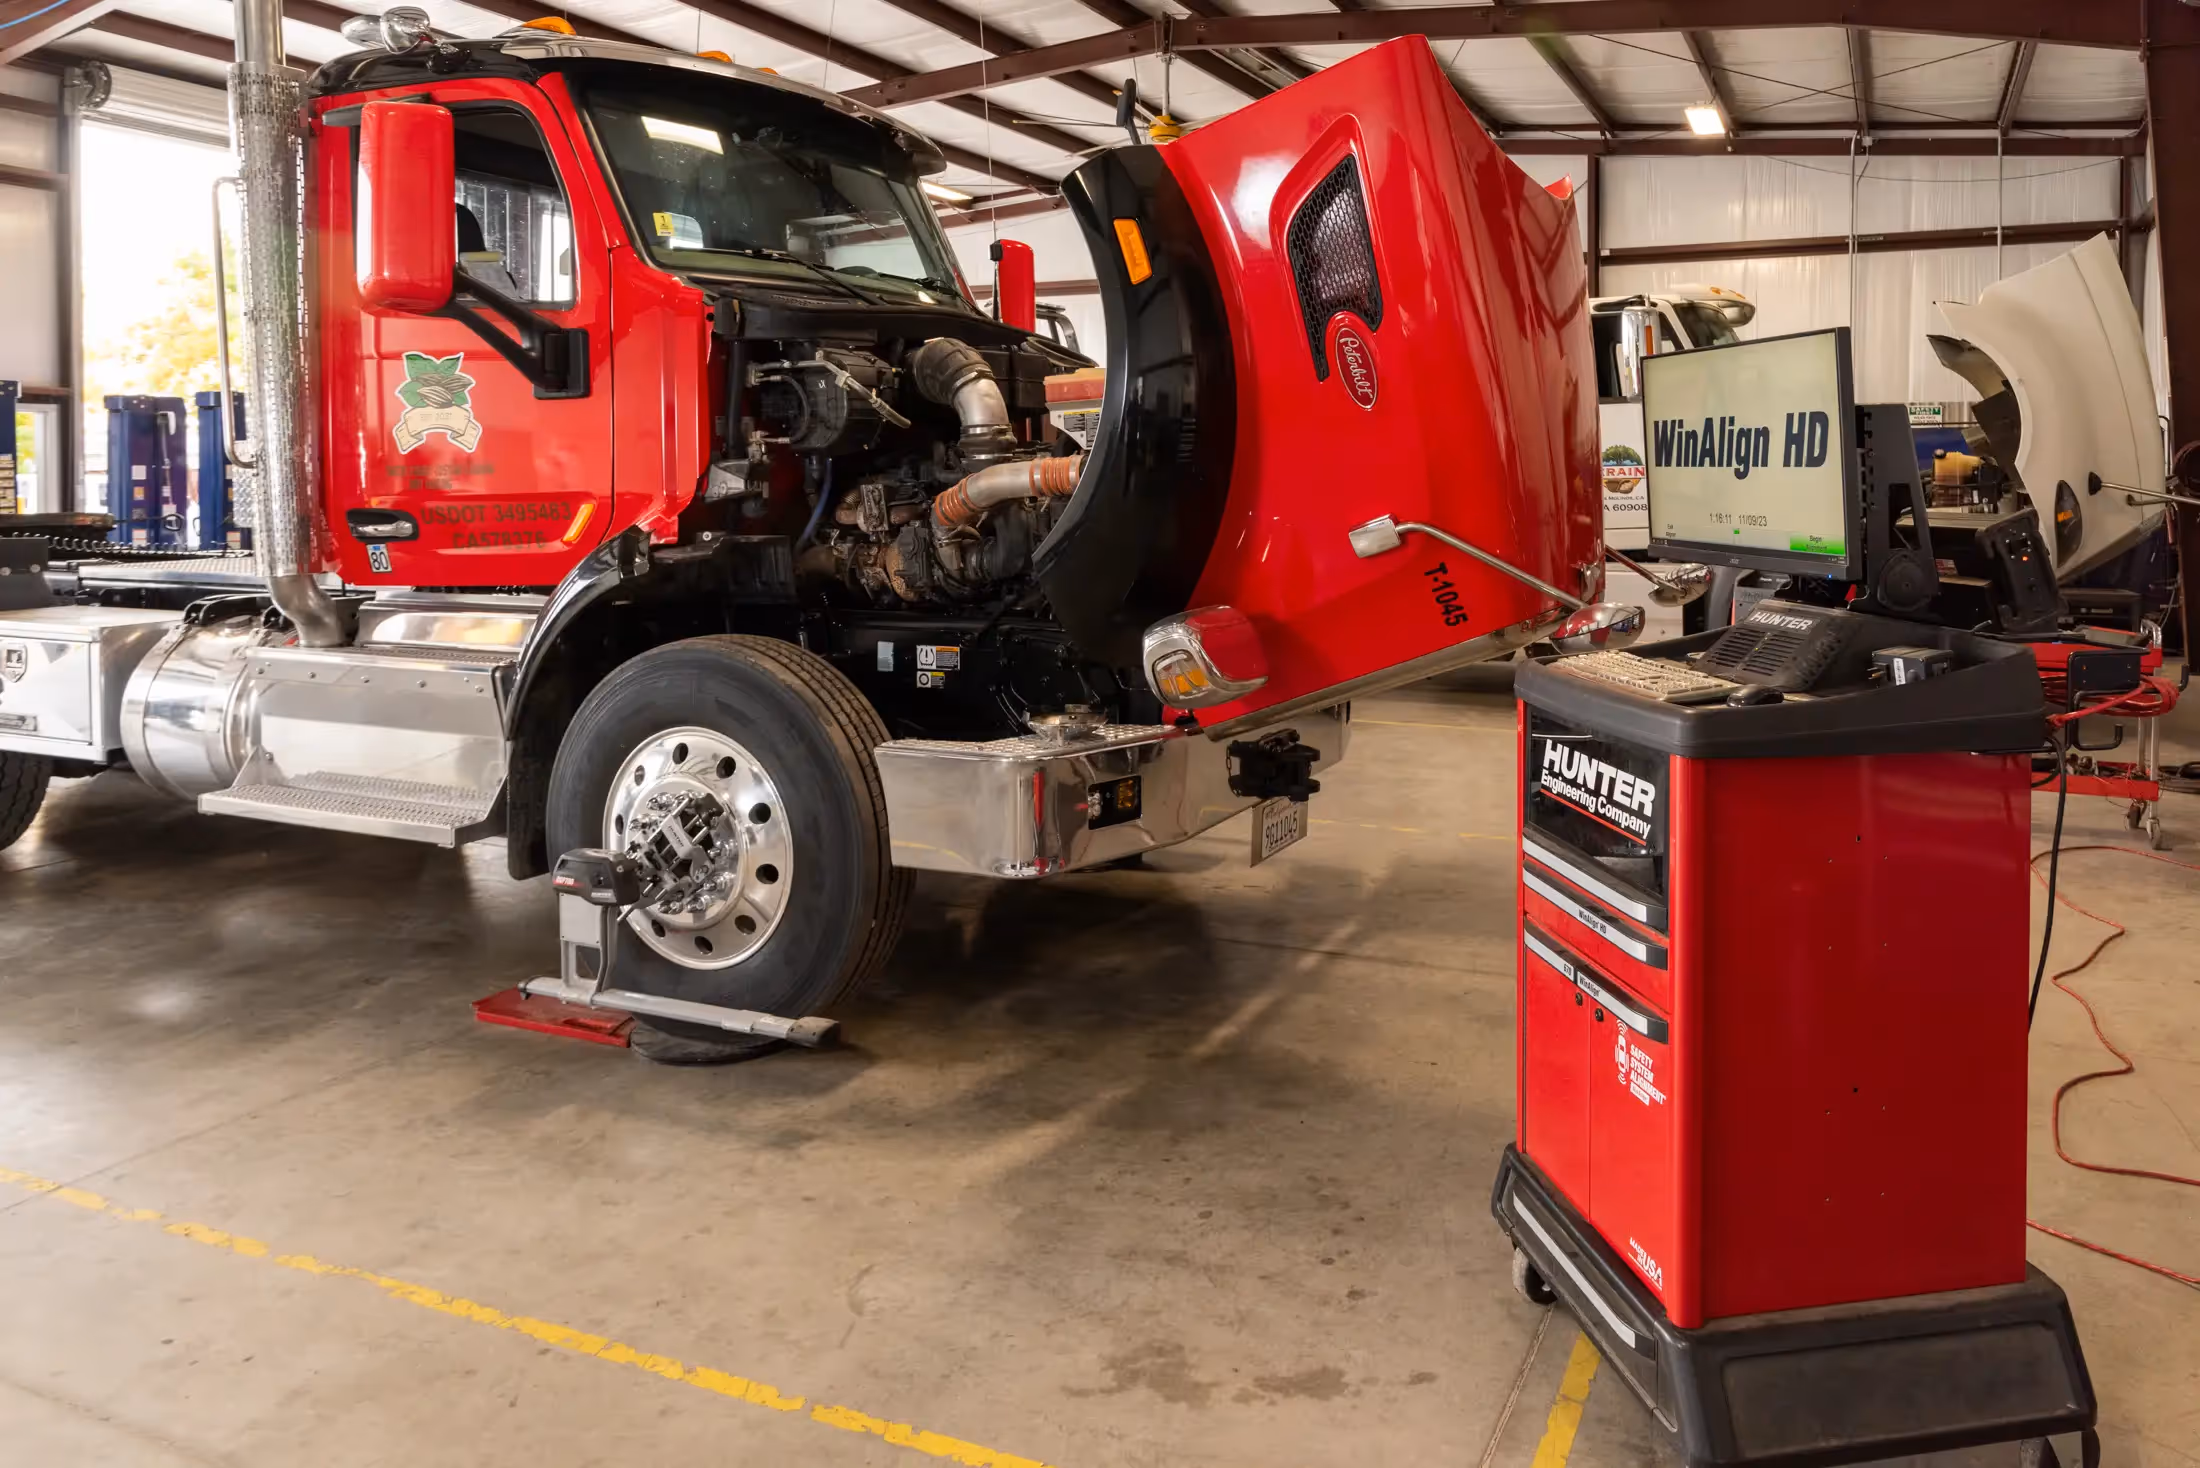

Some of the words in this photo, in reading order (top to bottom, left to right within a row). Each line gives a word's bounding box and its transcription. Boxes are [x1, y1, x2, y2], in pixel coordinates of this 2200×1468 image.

[1339, 337, 1373, 399] Peterbilt
[1653, 416, 1770, 480] WinAlign
[1782, 411, 1829, 468] HD
[420, 504, 486, 524] USDOT
[1612, 503, 1648, 512] 60908
[1738, 513, 1768, 527] 11/09/23
[371, 552, 389, 570] 80
[1424, 562, 1468, 626] T-1045
[1750, 611, 1813, 630] HUNTER
[1543, 738, 1656, 818] HUNTER
[1541, 768, 1597, 813] Engineering
[1597, 796, 1651, 840] Company
[1630, 1043, 1654, 1069] SAFETY
[1630, 1056, 1654, 1084] SYSTEM
[1630, 1069, 1665, 1105] ALIGNMENT
[1642, 1251, 1662, 1287] USA
